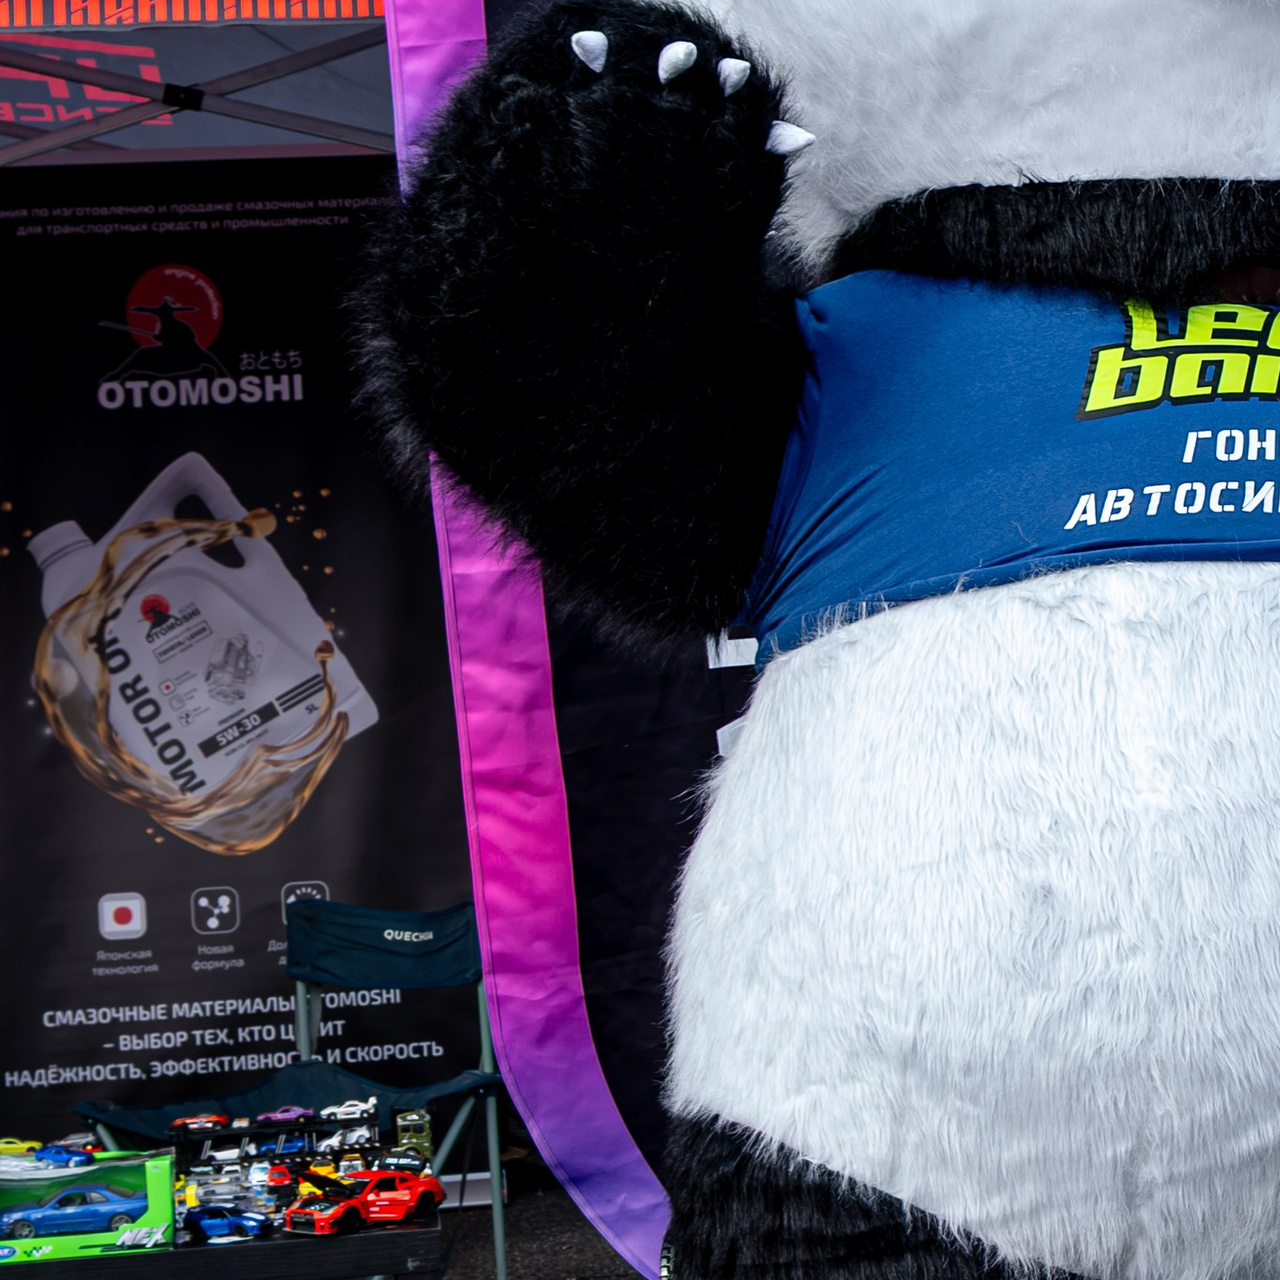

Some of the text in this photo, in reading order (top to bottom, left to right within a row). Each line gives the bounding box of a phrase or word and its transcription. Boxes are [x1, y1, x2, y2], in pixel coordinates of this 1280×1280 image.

[52, 205, 155, 217] изготовлению
[170, 202, 232, 215] продаже
[236, 199, 314, 211] смазочных
[317, 197, 395, 211] материал
[16, 224, 43, 236] для
[46, 222, 149, 237] транспортных
[151, 220, 208, 234] средств
[223, 216, 349, 231] промышленности
[97, 374, 303, 409] OTOMOSHI
[118, 674, 207, 796] MOTOR
[96, 949, 152, 962] Японская
[197, 944, 234, 955] Новая
[91, 963, 159, 977] технология
[191, 957, 245, 972] формула
[43, 989, 401, 1027] СМАЗОЧНЫЕ МАТЕРИАЛЫ OMOSHI
[119, 1030, 189, 1052] ВЫБОР
[191, 1028, 234, 1046] ТЕХ,
[238, 1024, 275, 1043] КТО
[281, 1019, 346, 1042] ЦИТ
[4, 1041, 443, 1089] НАДЁЖНОСТЬ, ЭФФЕКТИВНОС И СКОРОСТЬ
[116, 1222, 170, 1248] NEX
